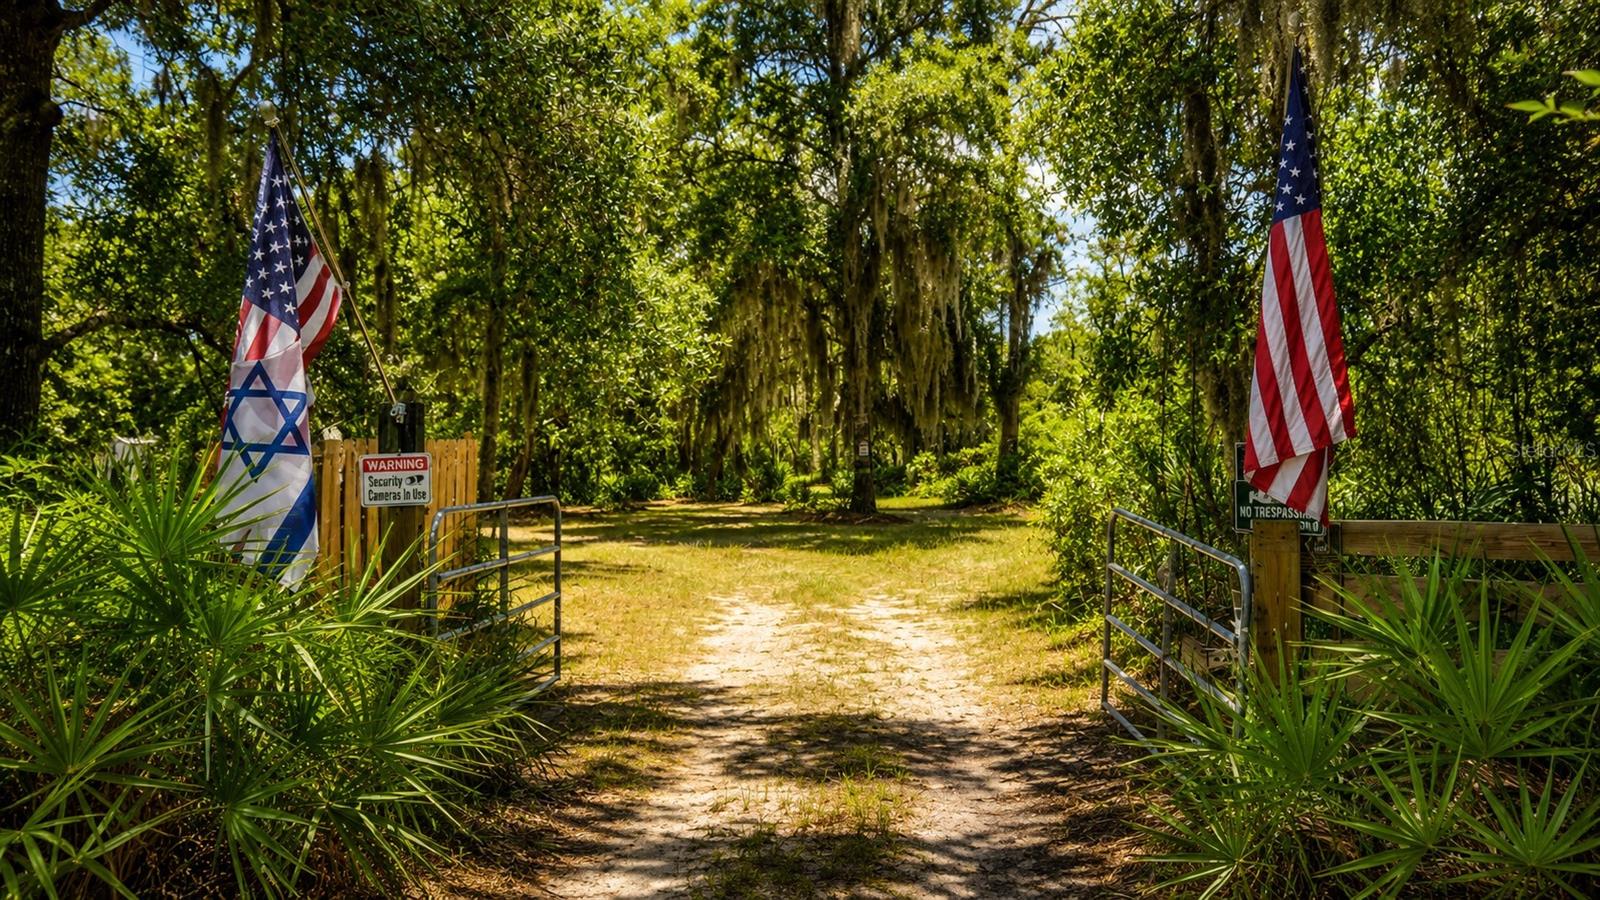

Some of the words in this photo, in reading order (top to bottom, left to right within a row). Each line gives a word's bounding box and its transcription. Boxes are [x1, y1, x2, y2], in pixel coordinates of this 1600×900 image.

[366, 458, 425, 471] WARNING
[368, 475, 403, 489] Security
[368, 489, 402, 501] Cameras
[403, 488, 411, 501] In
[412, 488, 427, 500] Use
[1239, 505, 1252, 518] NO
[1253, 506, 1312, 519] TRESPASSI
